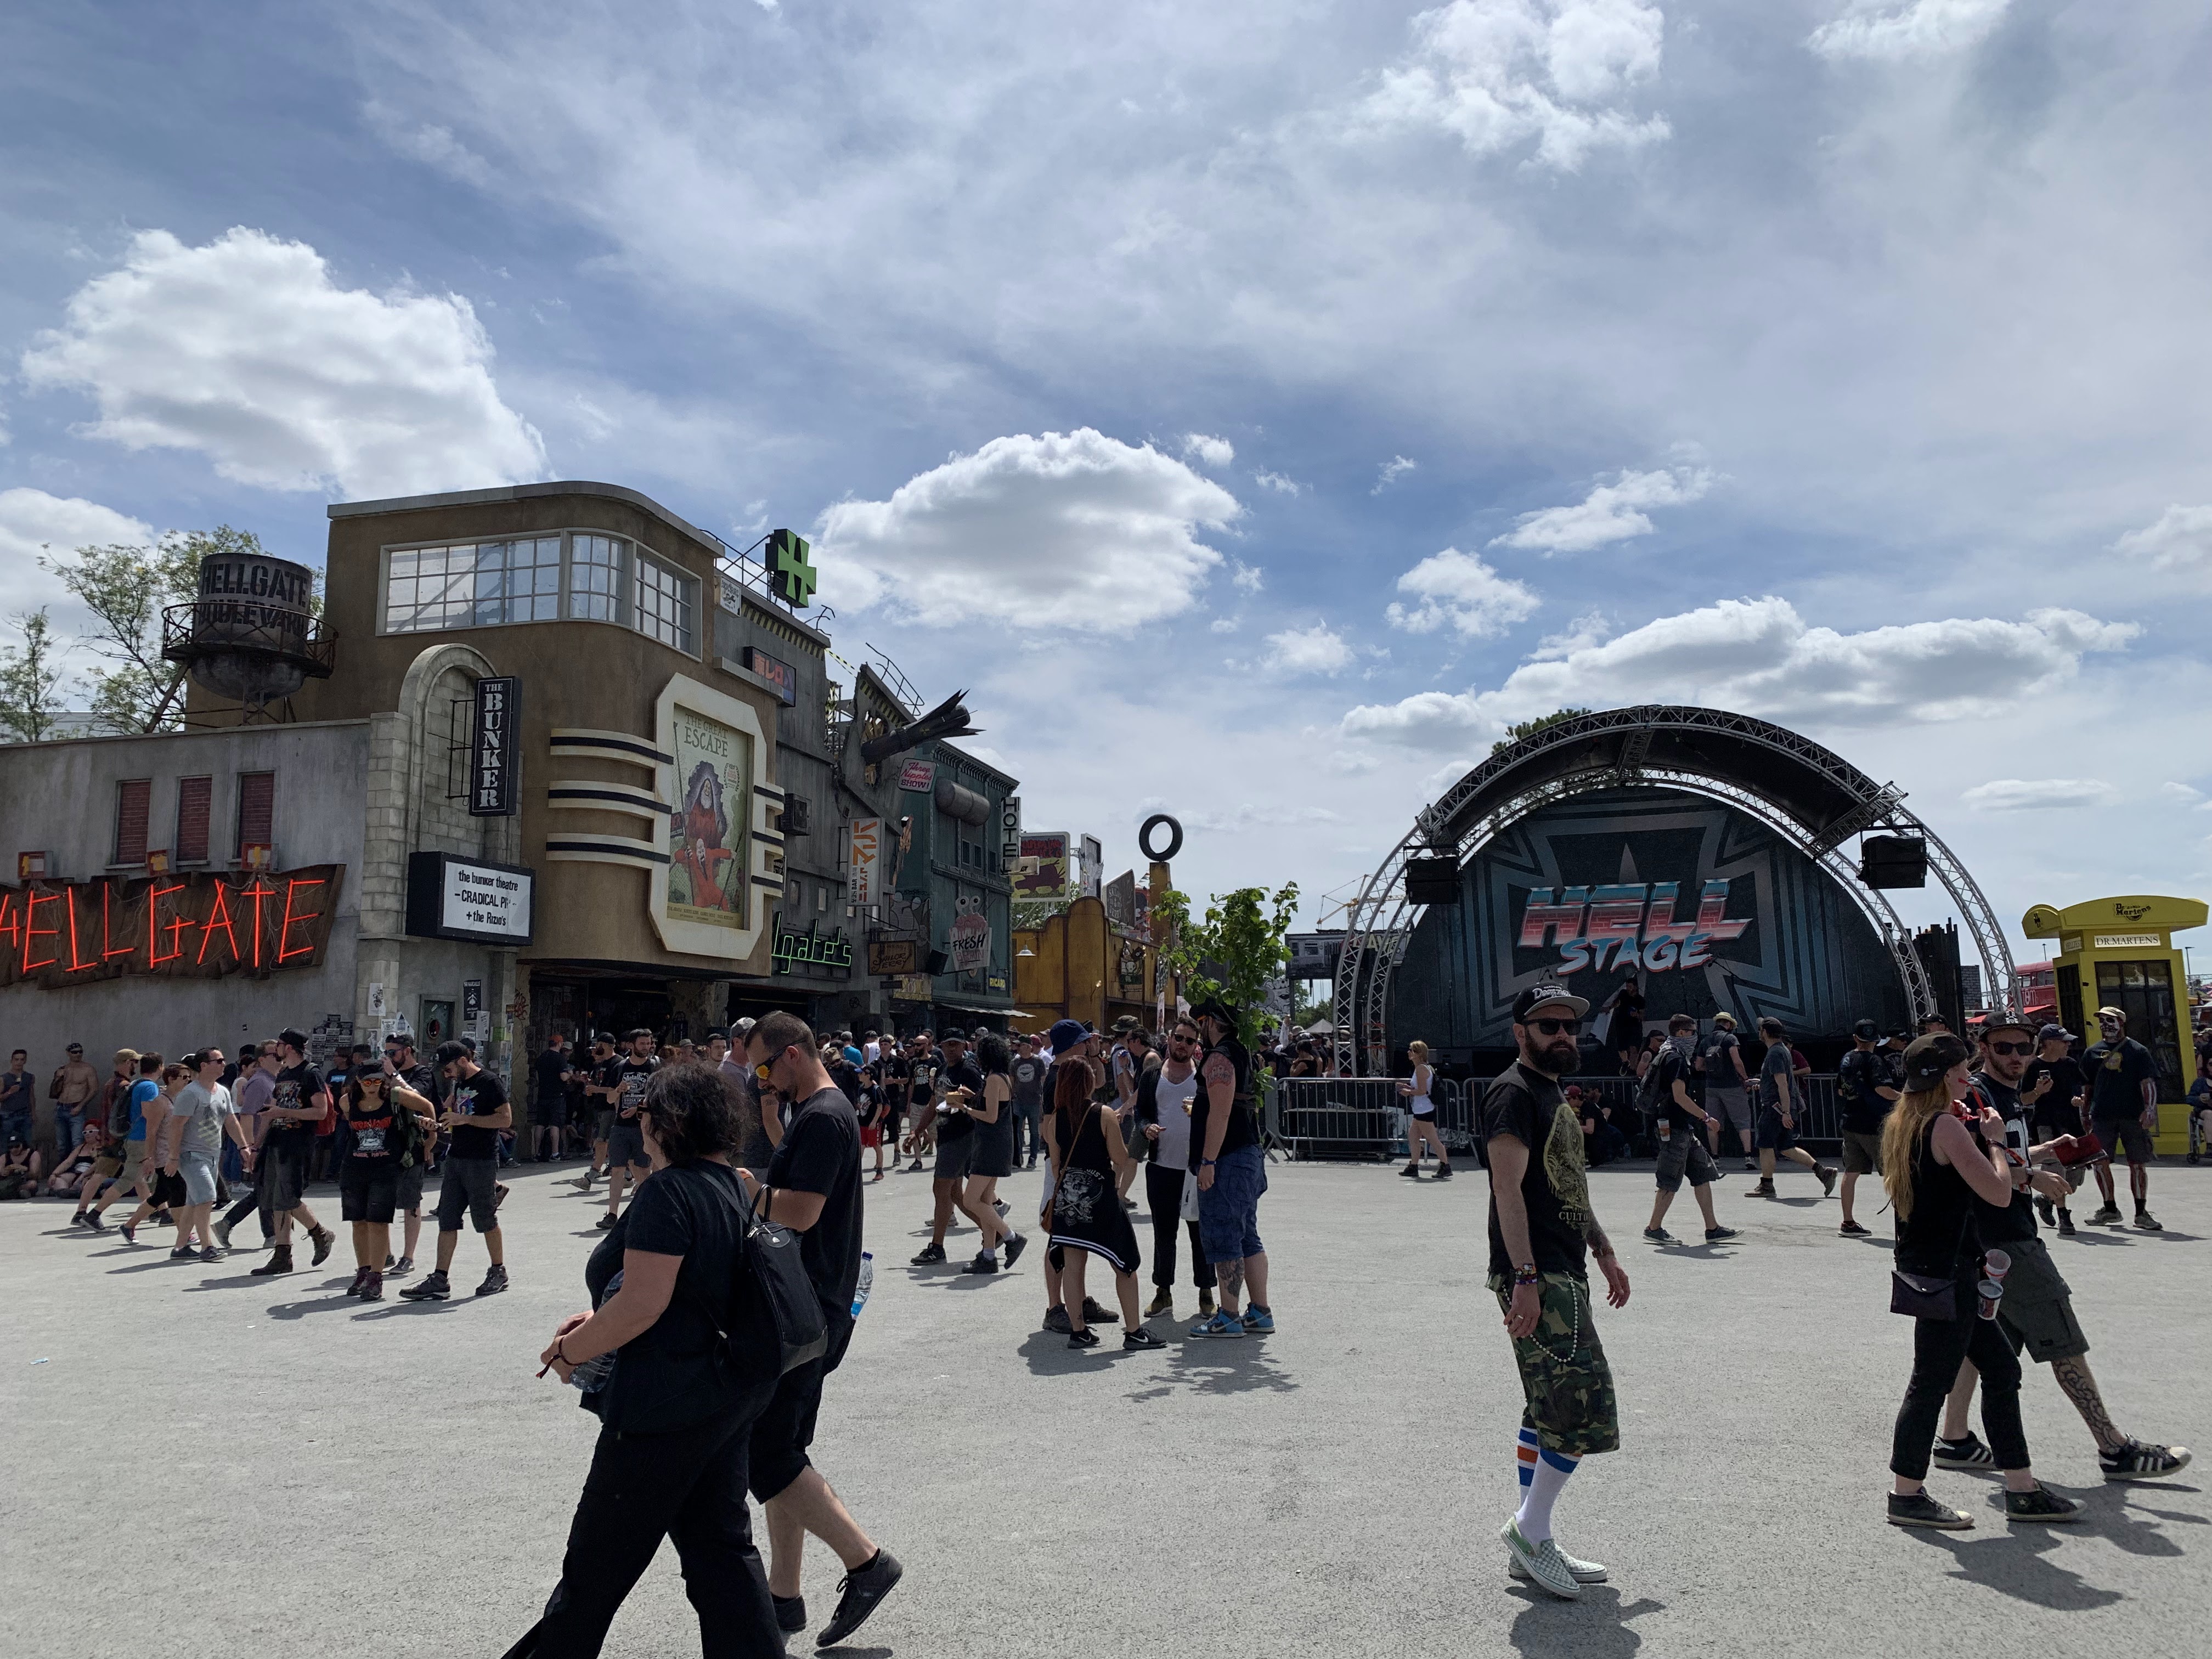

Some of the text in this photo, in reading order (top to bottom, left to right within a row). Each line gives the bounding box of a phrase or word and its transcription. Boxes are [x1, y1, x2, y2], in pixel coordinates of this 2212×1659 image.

[201, 563, 308, 608] HELLGATE
[485, 682, 503, 692] THE
[685, 713, 729, 740] THE GREAT
[479, 693, 503, 808] BUNKER
[684, 725, 729, 758] ESCAPE
[900, 769, 933, 781] Nipples
[908, 762, 931, 772] Three
[901, 778, 930, 789] SHOW!
[1003, 797, 1018, 872] HOTEL
[458, 870, 518, 891] the bunker theatre
[1517, 878, 1753, 948] HELL
[2115, 905, 2152, 916] Martens
[1556, 932, 1714, 976] STAGE
[989, 977, 1006, 988] RICARD
